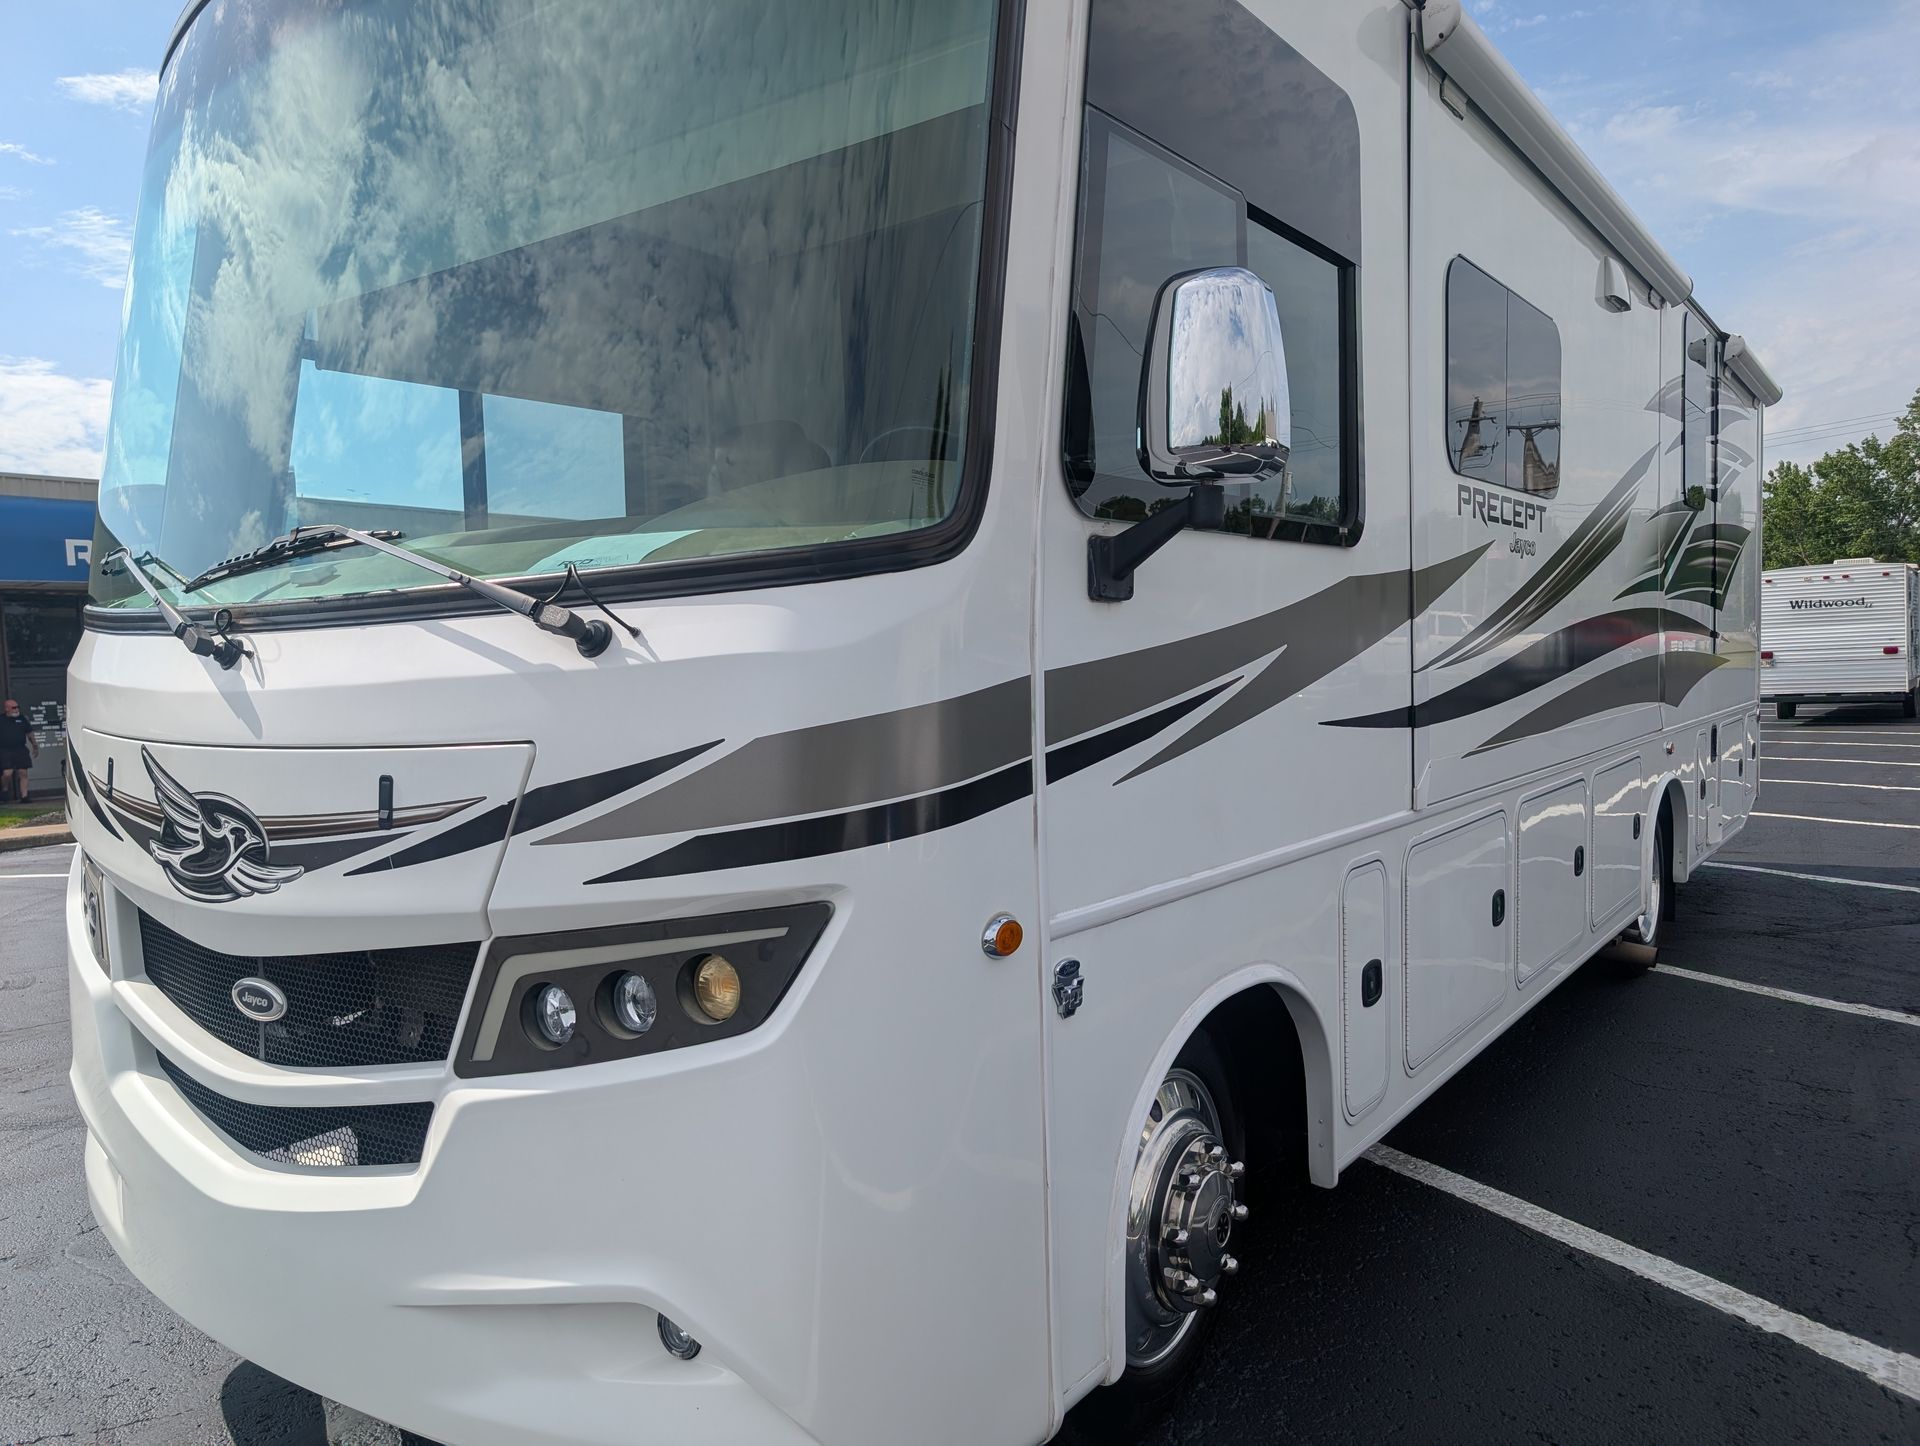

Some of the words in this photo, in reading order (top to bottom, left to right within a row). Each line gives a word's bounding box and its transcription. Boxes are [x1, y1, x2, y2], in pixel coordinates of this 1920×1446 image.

[1458, 483, 1547, 533] PRECEPT
[1509, 532, 1536, 559] Jayco
[1789, 597, 1865, 609] Wildwood
[242, 991, 268, 1007] Jayco
